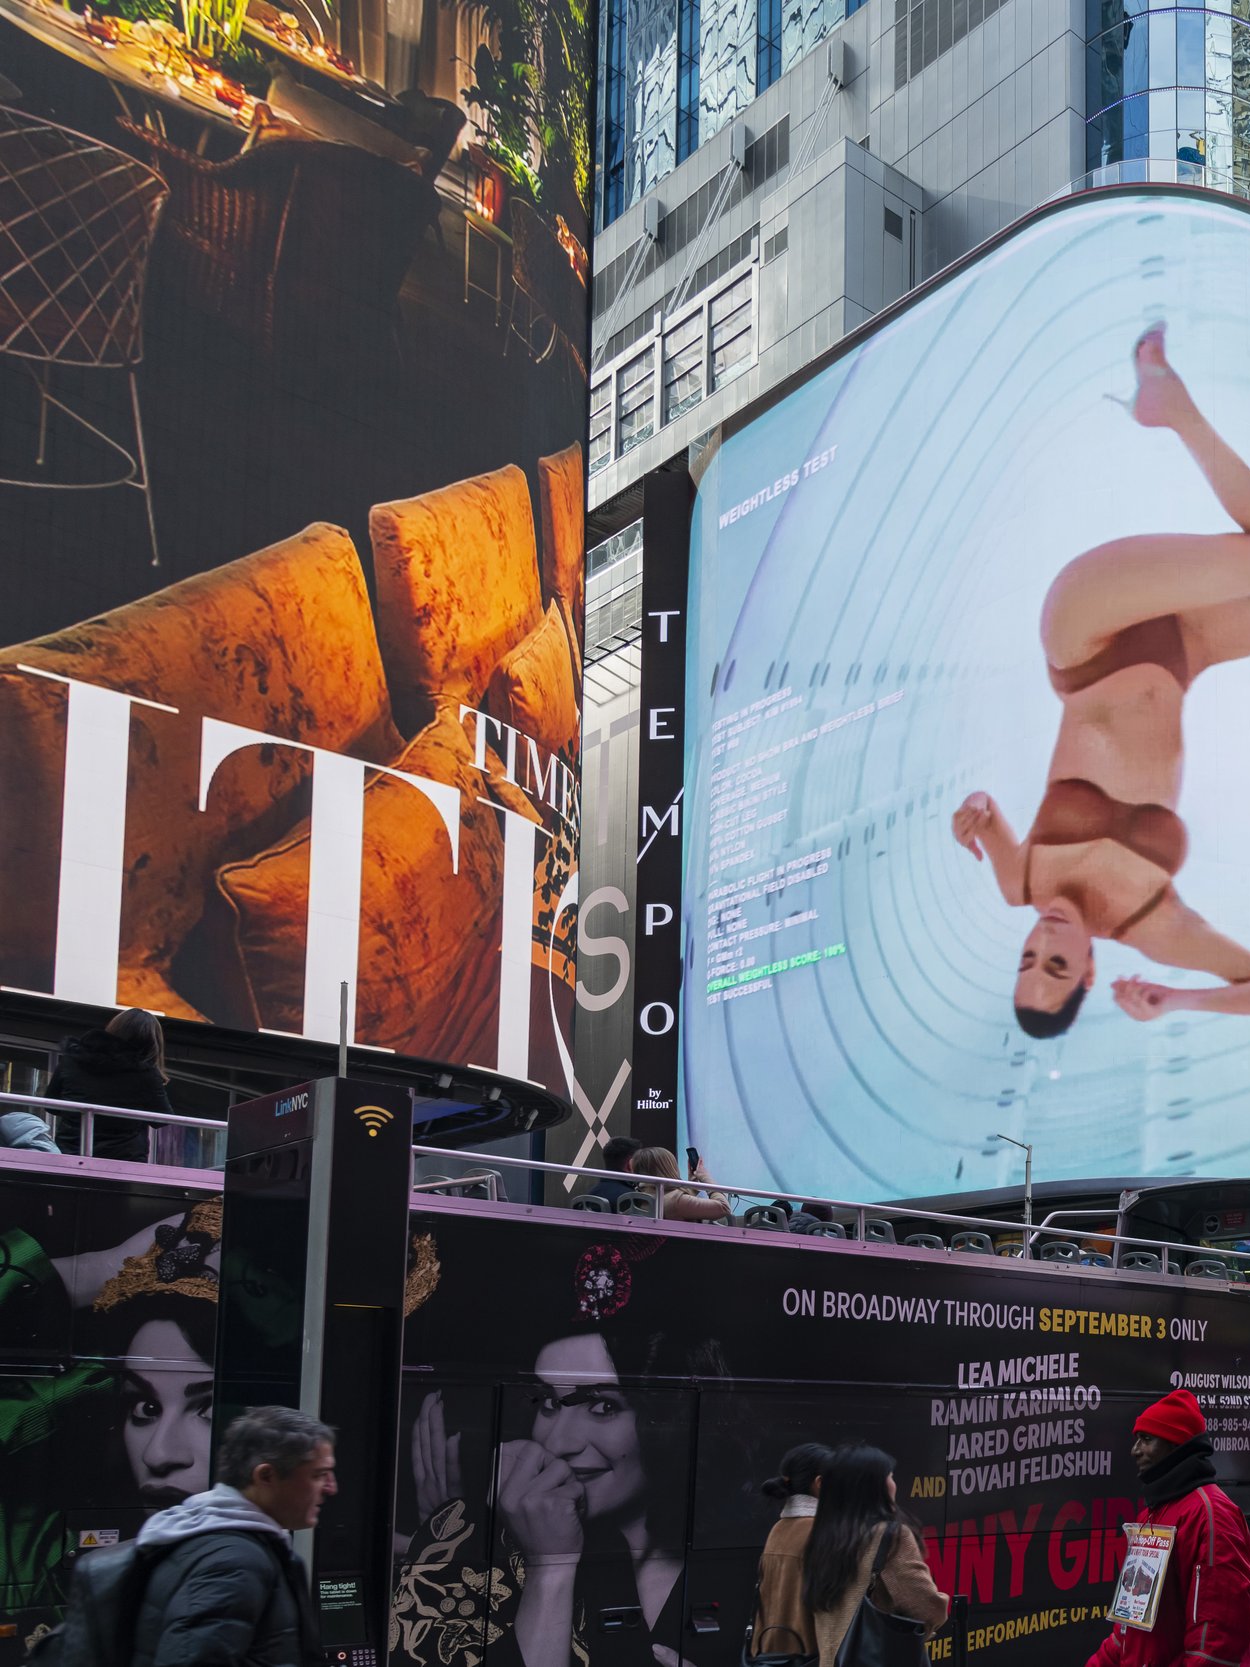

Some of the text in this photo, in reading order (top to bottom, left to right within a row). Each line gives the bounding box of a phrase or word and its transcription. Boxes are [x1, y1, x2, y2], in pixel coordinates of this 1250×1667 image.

[719, 445, 838, 529] WEIGHTLESS TEST
[763, 864, 828, 893] FIELD DISABLED
[738, 961, 787, 982] WEIGHTLESS
[790, 951, 820, 966] SCORE:
[723, 979, 772, 999] SUCCESSFUL
[275, 1092, 308, 1117] LinkNYC
[648, 1088, 661, 1100] by
[783, 1288, 1208, 1341] ON BROADWAY THROUGH SEPTEMBER 3 ONLY
[958, 1353, 1079, 1389] LEA MICHELE
[1184, 1373, 1220, 1388] AUGUST
[931, 1385, 1101, 1426] RAMIN KARIMLOO
[1220, 1395, 1242, 1409] 52ND
[946, 1418, 1085, 1461] JARED GRIMES
[910, 1451, 1112, 1498] AND TOVAH FELDSHUH
[1048, 1497, 1146, 1591] GIR
[1156, 1536, 1169, 1548] Pass
[966, 1608, 1067, 1652] ERFORMANCE
